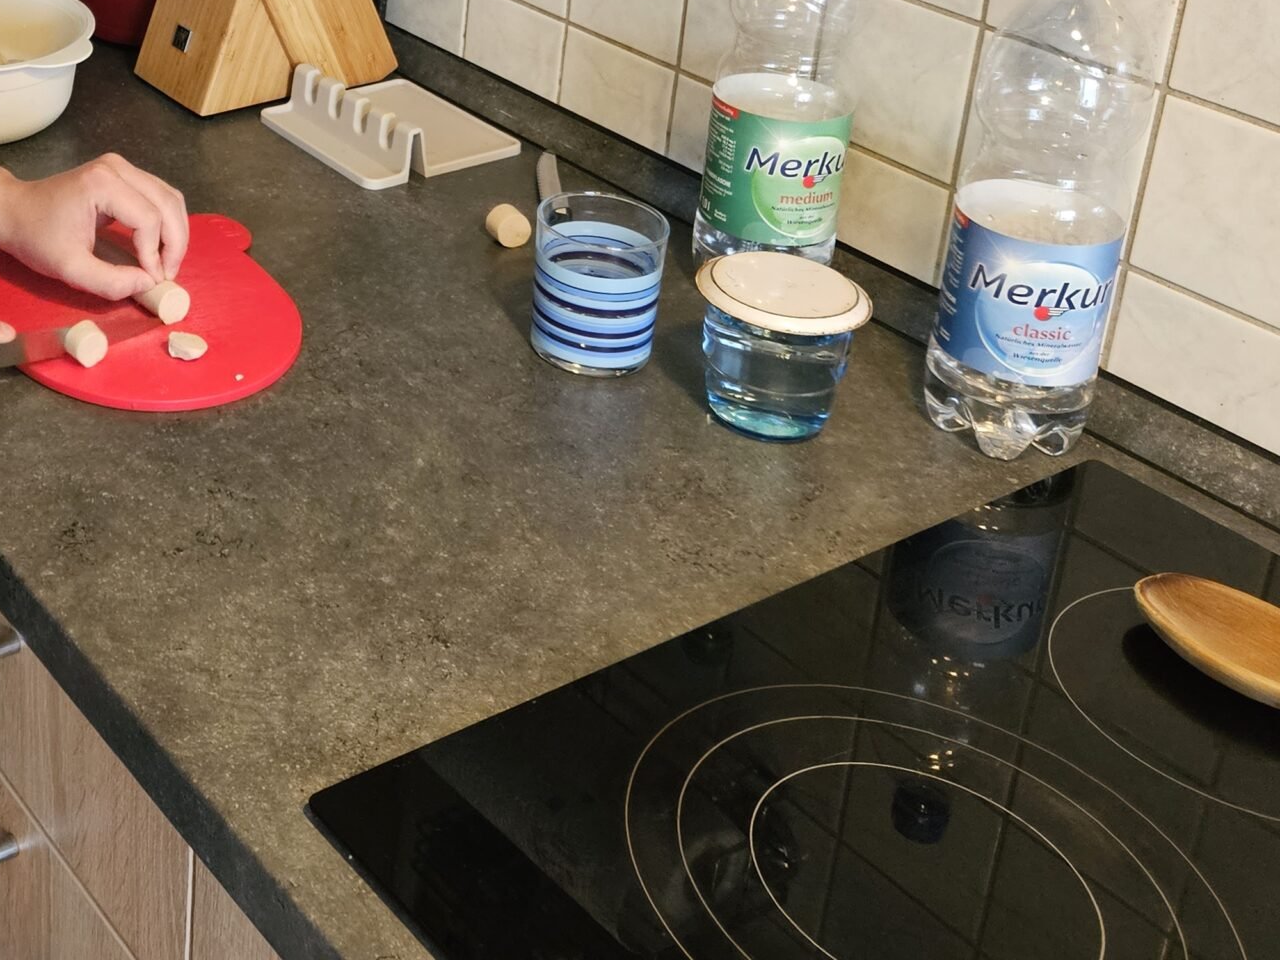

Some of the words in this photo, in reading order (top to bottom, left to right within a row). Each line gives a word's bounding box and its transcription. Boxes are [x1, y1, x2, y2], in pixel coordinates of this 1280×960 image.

[745, 147, 846, 179] Merku
[780, 191, 833, 205] medium
[970, 263, 1113, 311] Merkur
[1012, 324, 1072, 341] classic
